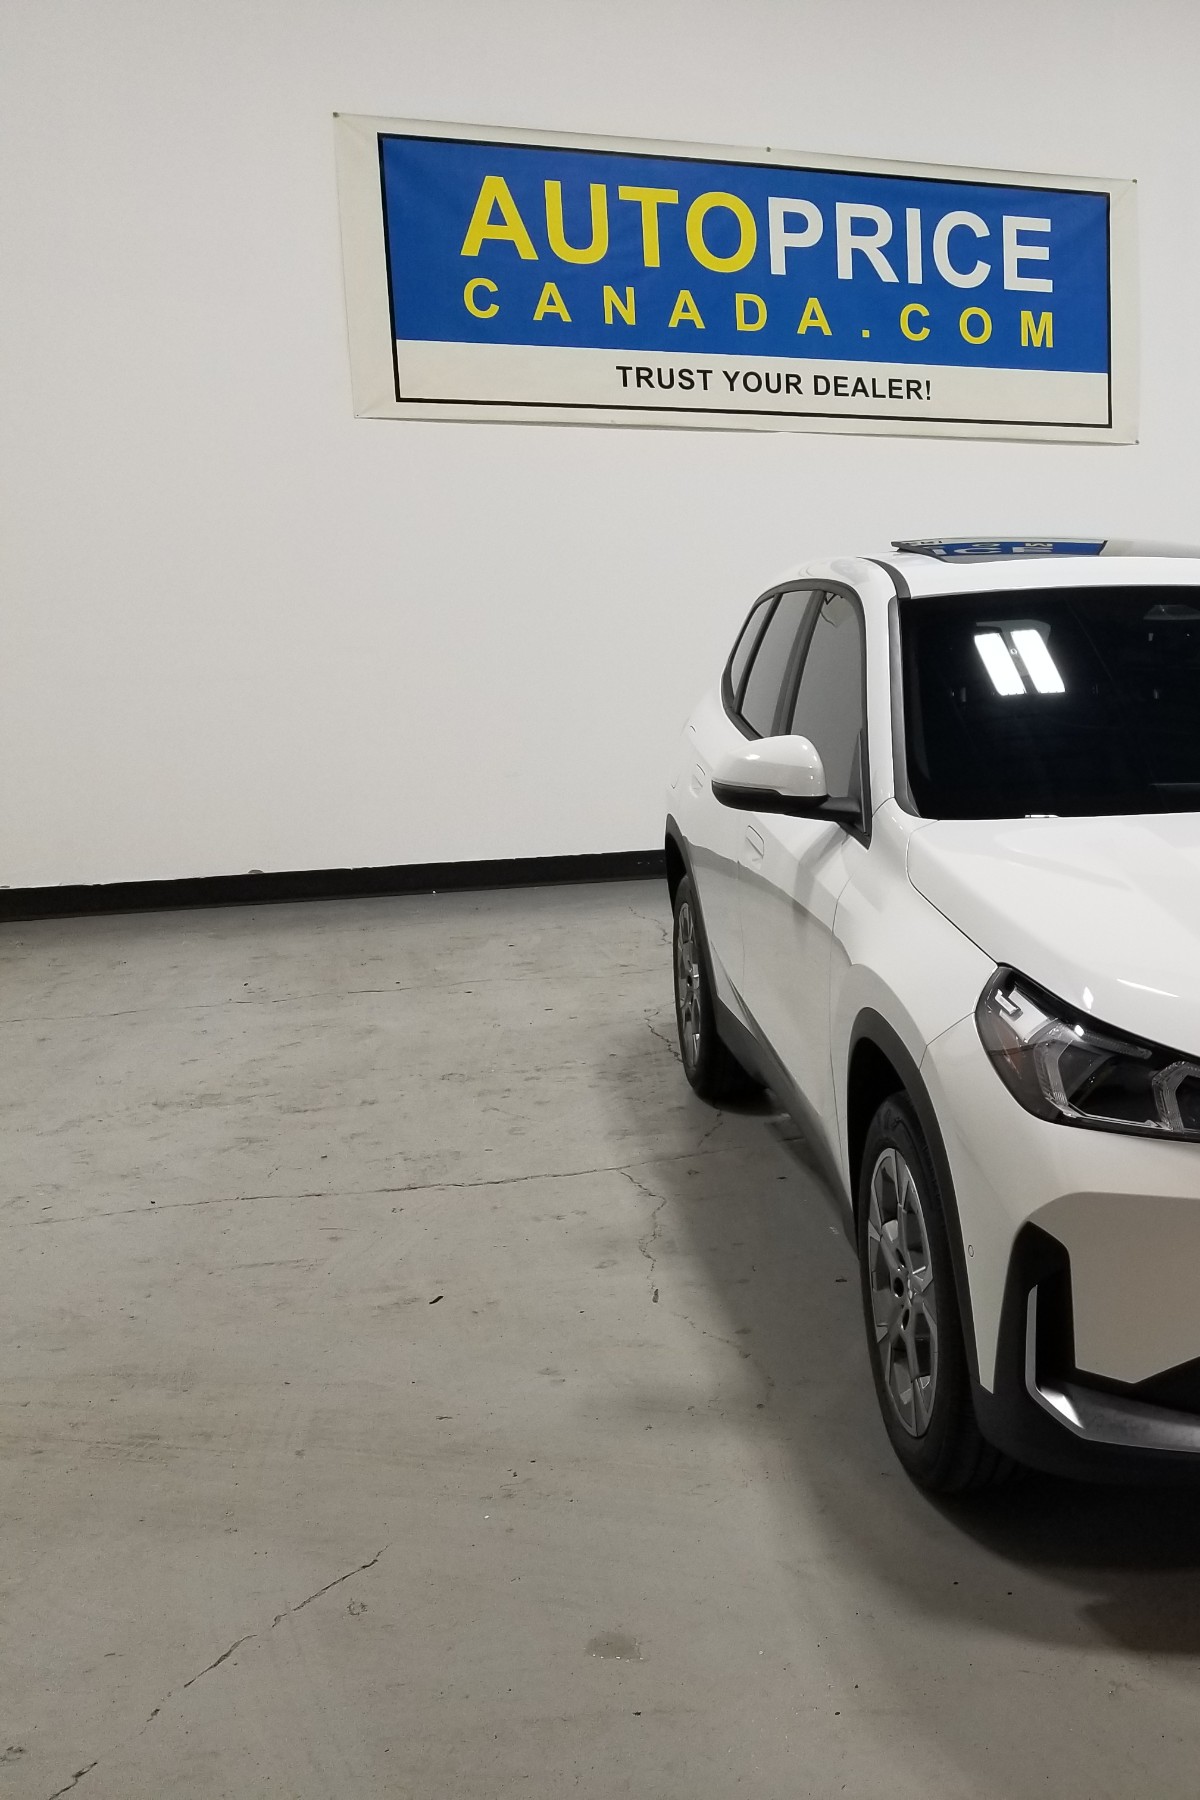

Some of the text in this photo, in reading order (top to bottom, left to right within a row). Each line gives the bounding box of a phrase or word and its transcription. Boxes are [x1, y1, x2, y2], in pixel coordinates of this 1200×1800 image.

[460, 175, 1054, 293] AUTOPRICE
[463, 277, 1054, 348] CANADA.COM
[615, 365, 931, 401] TRUST YOUR DEALER!
